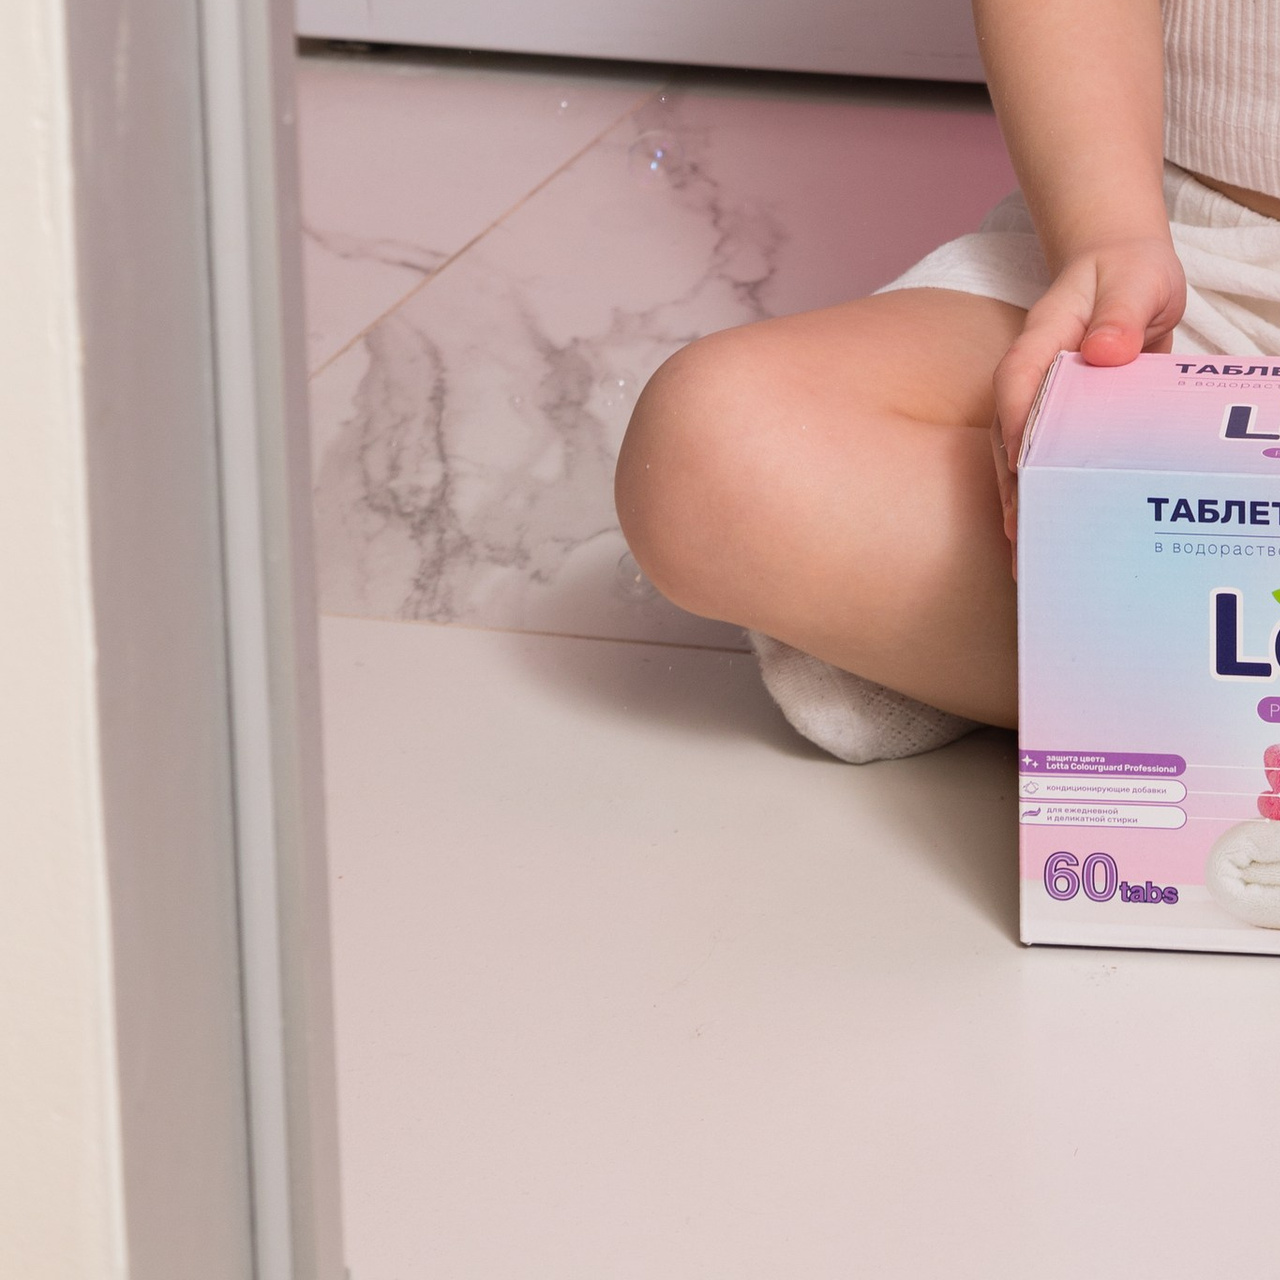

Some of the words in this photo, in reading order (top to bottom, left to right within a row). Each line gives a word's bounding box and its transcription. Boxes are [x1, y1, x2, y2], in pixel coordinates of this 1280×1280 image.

[1155, 542, 1163, 553] в
[1046, 755, 1078, 763] защита
[1080, 756, 1105, 764] цвета
[1070, 763, 1123, 773] Colourguard
[1124, 764, 1177, 773] Professional
[1046, 784, 1130, 794] кондиционирующие
[1132, 785, 1167, 795] добавки
[1065, 807, 1119, 816] ежедневной
[1054, 815, 1106, 824] деликатной
[1107, 817, 1138, 825] стирки
[1044, 851, 1118, 902] 60
[1119, 881, 1179, 905] tabs
